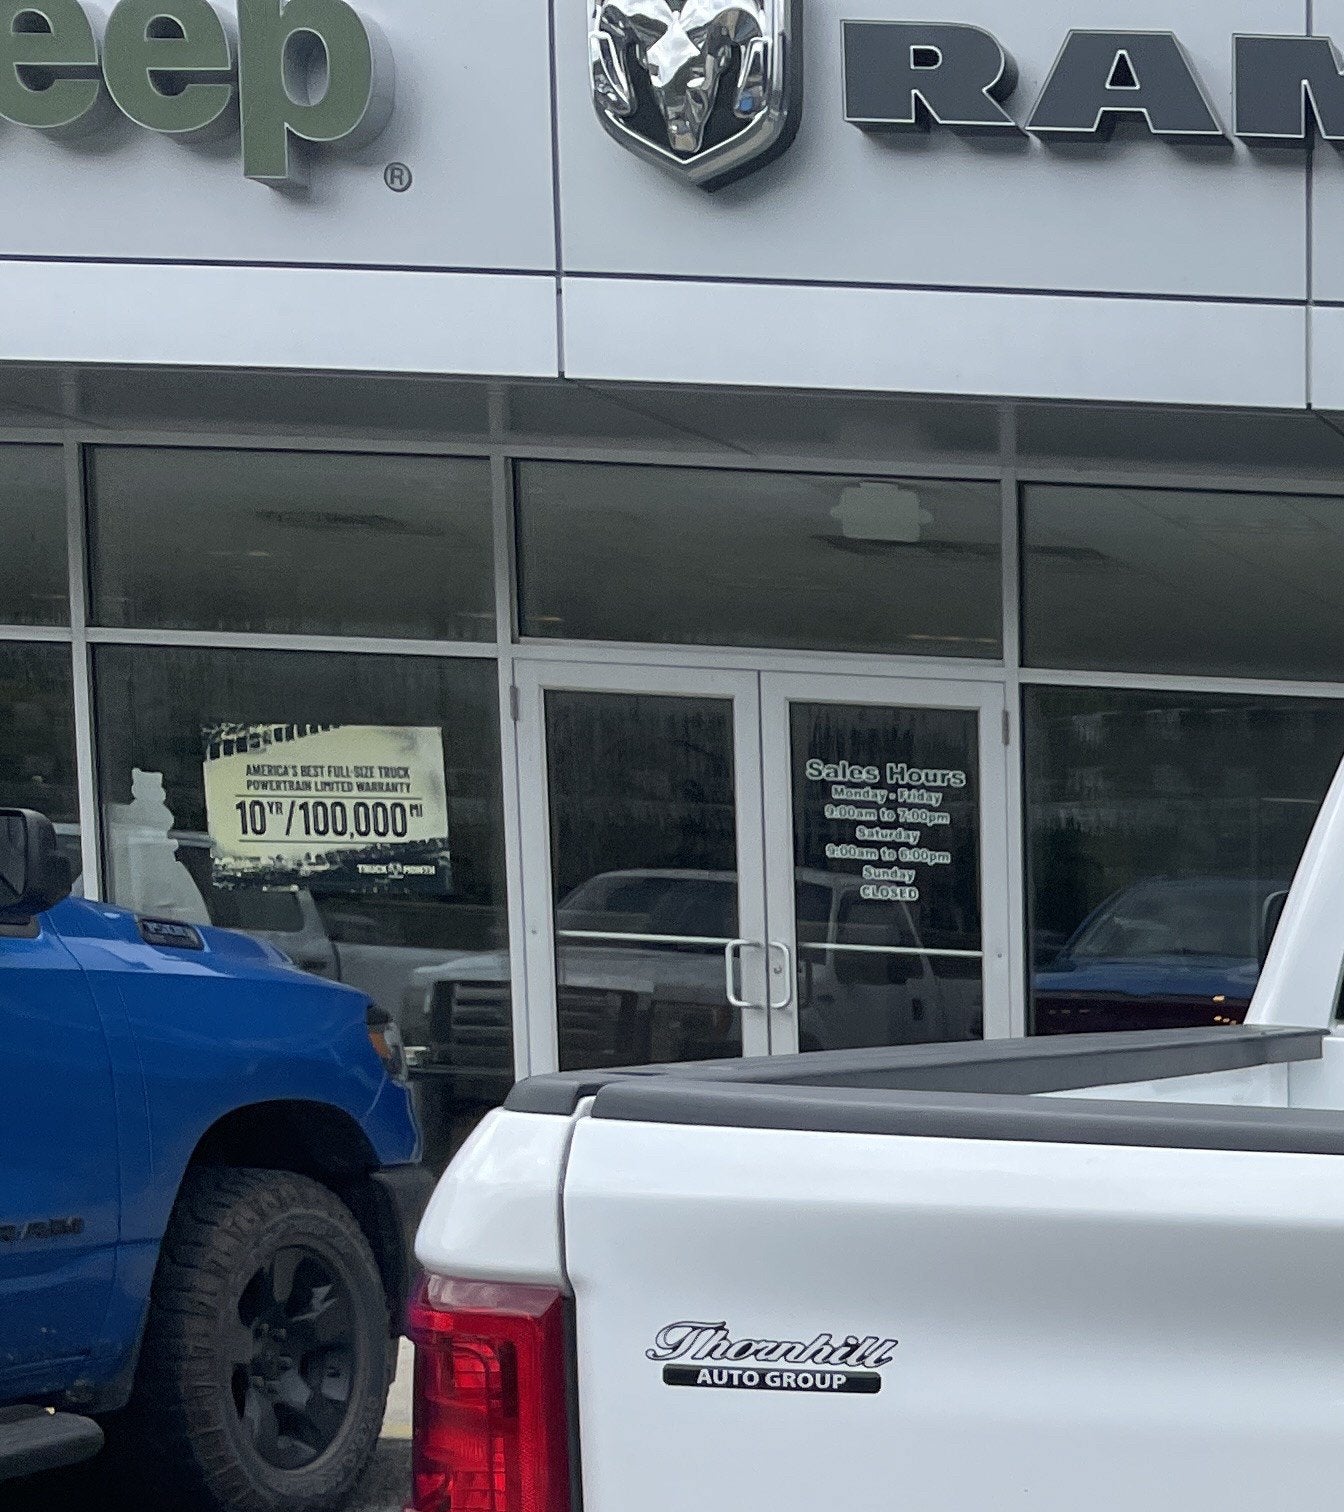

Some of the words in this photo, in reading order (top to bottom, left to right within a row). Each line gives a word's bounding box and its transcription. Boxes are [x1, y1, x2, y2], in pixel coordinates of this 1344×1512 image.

[245, 763, 298, 777] AMERICA'S
[301, 764, 325, 778] BEST
[378, 766, 411, 779] TRUCK
[805, 758, 880, 784] Sales
[886, 763, 967, 788] Hours
[246, 779, 312, 792] POWERTRAIN
[315, 780, 353, 793] LIMITED
[356, 781, 411, 794] WARRANTY
[831, 784, 888, 805] Monday
[897, 788, 943, 807] Friday
[824, 804, 878, 821] 9:00am
[880, 808, 896, 823] to
[897, 807, 951, 827] 7:00pm
[855, 825, 921, 845] Saturday
[880, 846, 897, 862] to
[862, 864, 916, 884] Sunday
[859, 885, 920, 901] CLOSED
[645, 1320, 899, 1368] Thornhill
[697, 1368, 759, 1388] AUTO
[764, 1370, 848, 1390] GROUP
